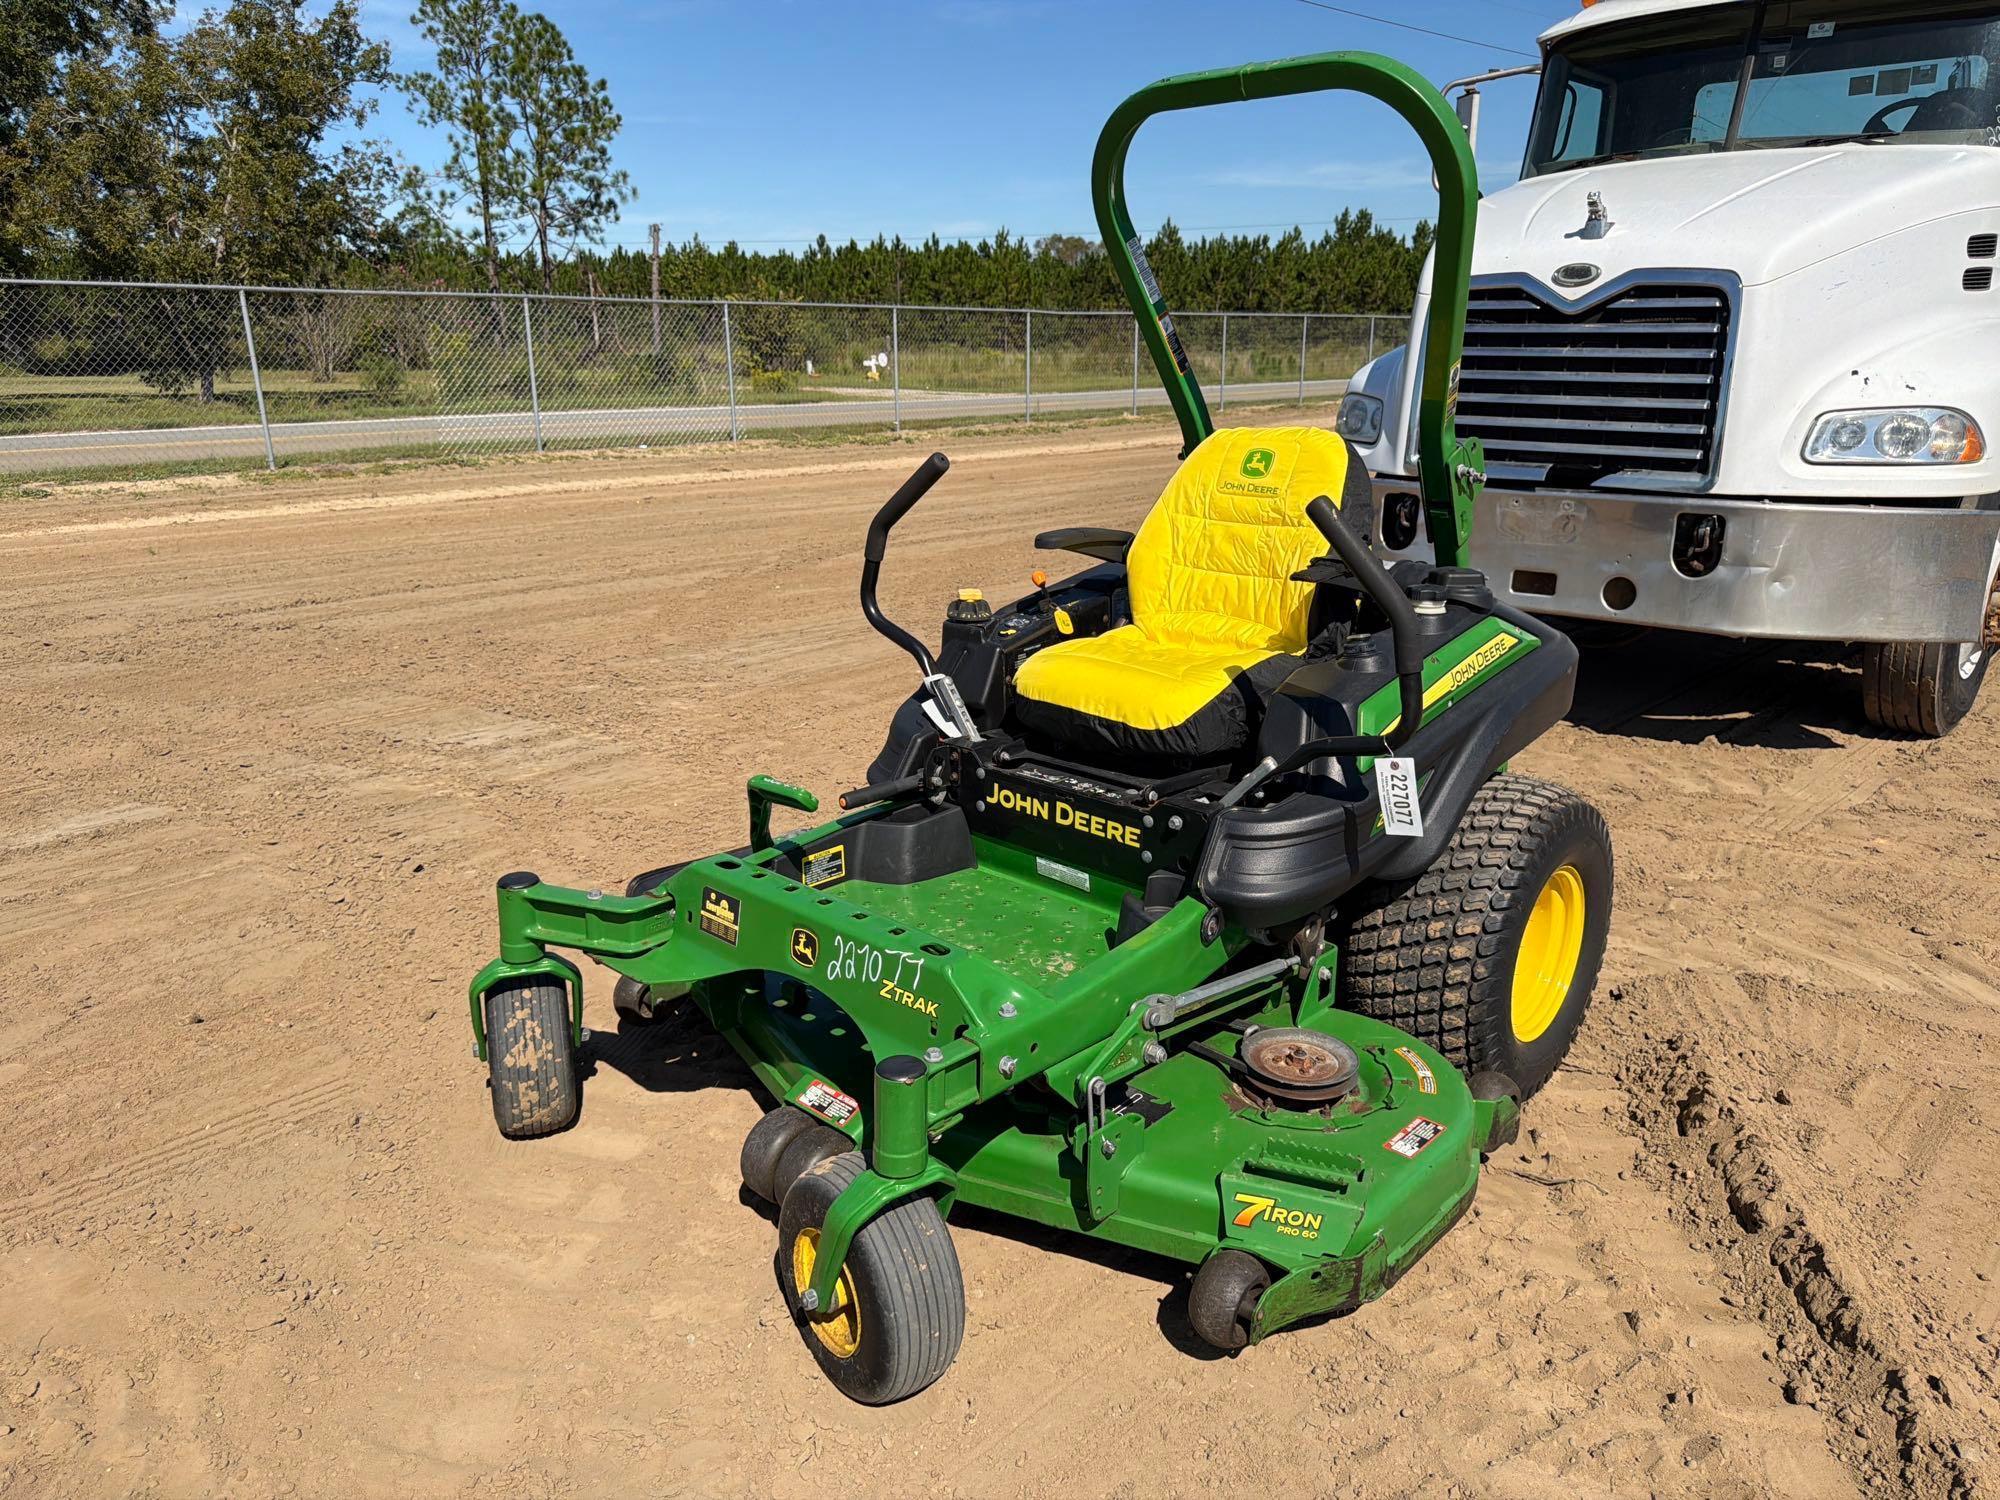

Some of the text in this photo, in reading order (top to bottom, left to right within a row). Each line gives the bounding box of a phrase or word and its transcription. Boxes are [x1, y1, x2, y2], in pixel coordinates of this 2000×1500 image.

[1220, 481, 1279, 495] JOHN DEERE
[1450, 638, 1508, 689] JOHN DEERE
[985, 782, 1049, 820] JOHN
[1055, 800, 1142, 848] DEERE
[1391, 774, 1414, 826] 227077
[879, 979, 940, 1018] ZTRAK
[1276, 1225, 1318, 1239] PRO 60
